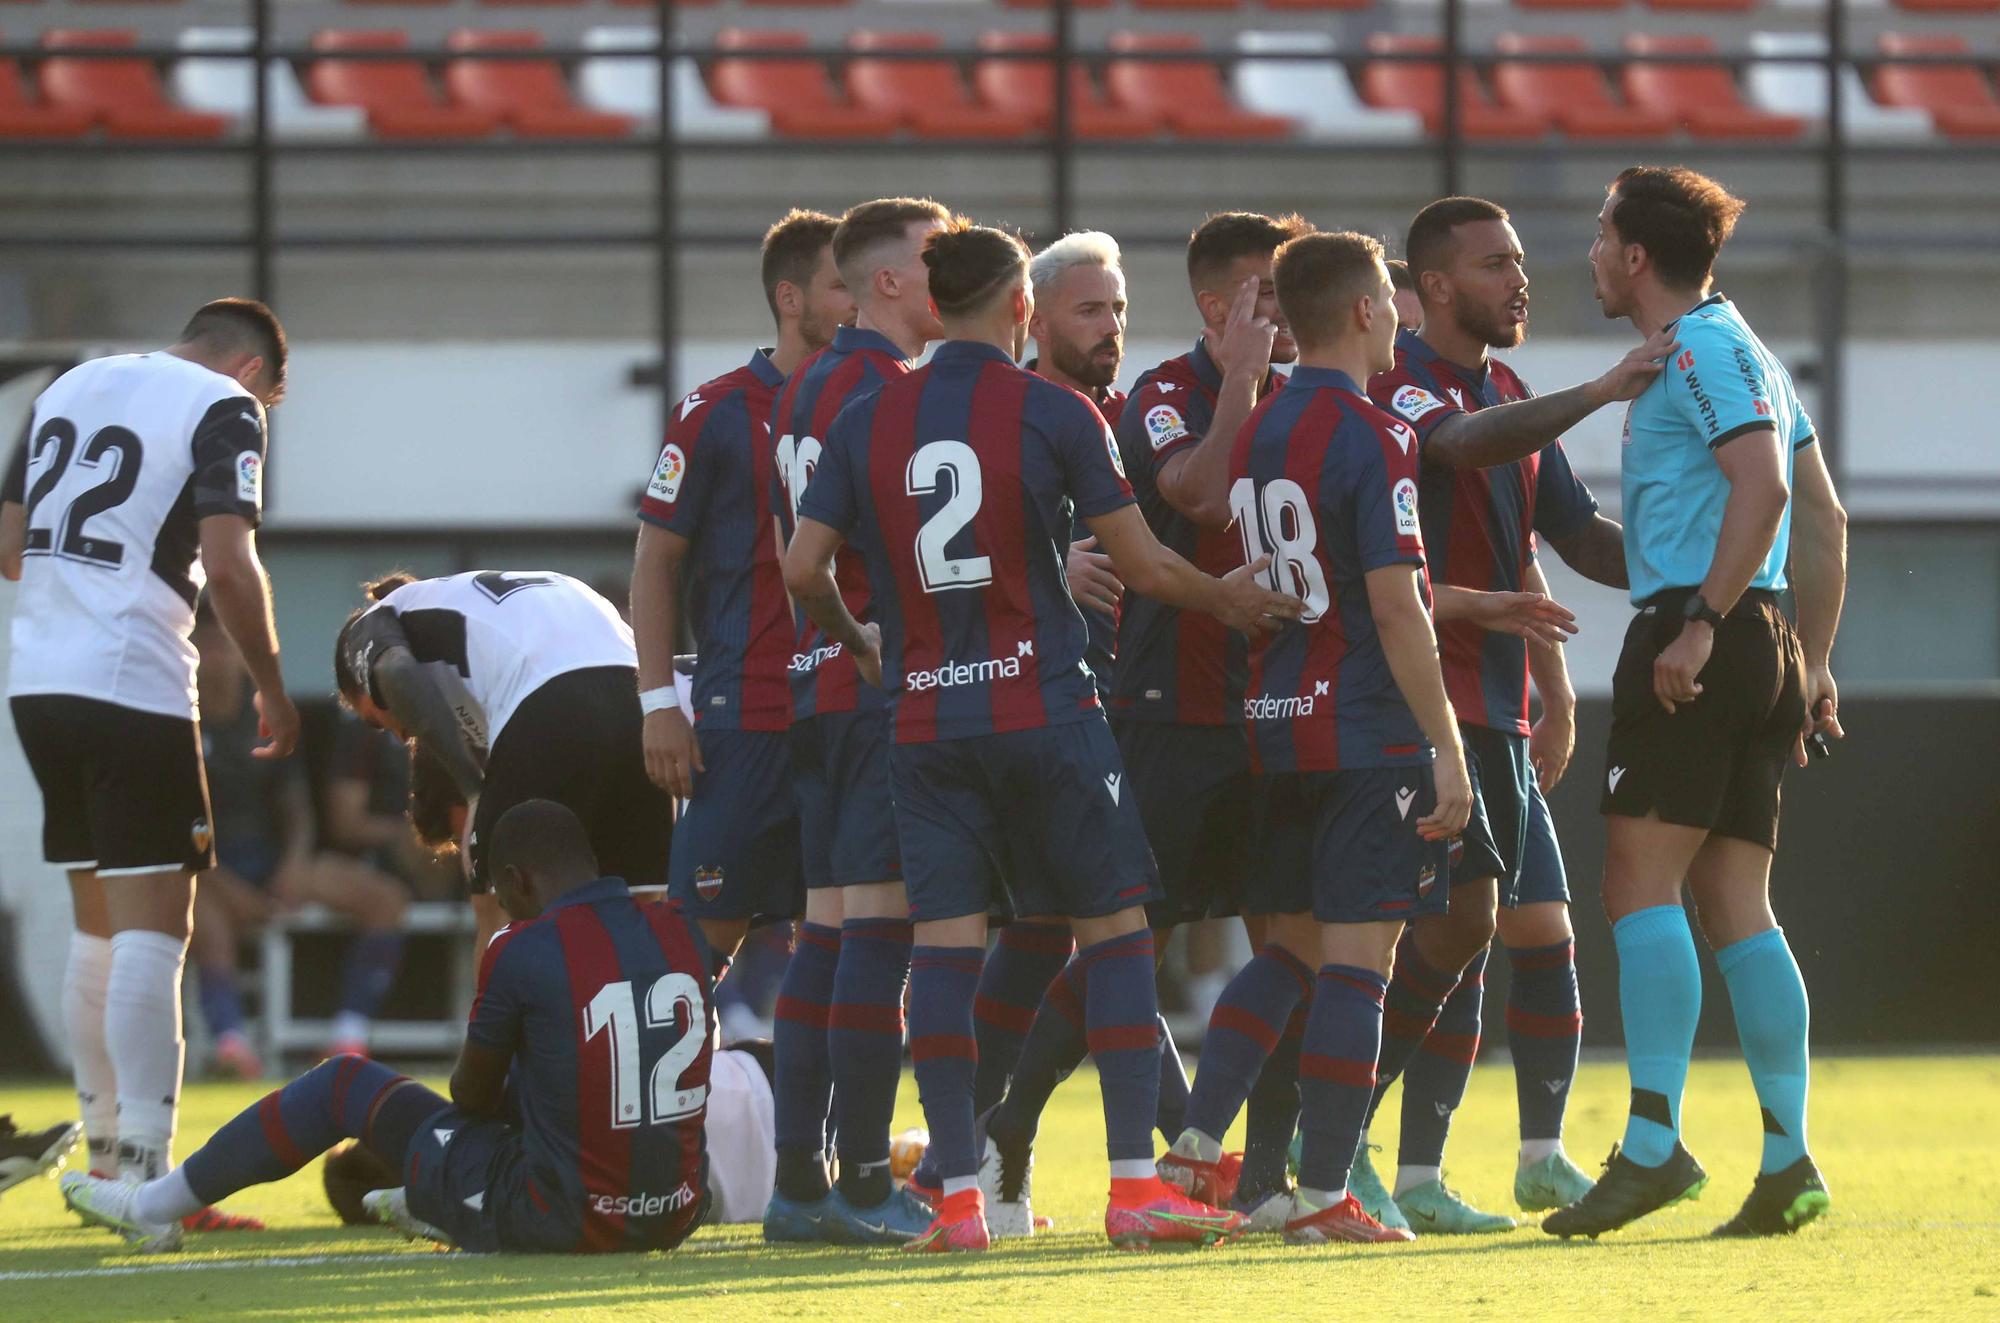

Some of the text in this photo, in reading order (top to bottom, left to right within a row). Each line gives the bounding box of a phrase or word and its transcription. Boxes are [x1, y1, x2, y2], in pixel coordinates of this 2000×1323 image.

[1686, 370, 1720, 435] WÜRTH
[23, 417, 143, 570] 22
[906, 440, 993, 593] 2
[1222, 477, 1330, 624] 18
[906, 656, 1020, 692] sesderma
[583, 972, 707, 1129] 12
